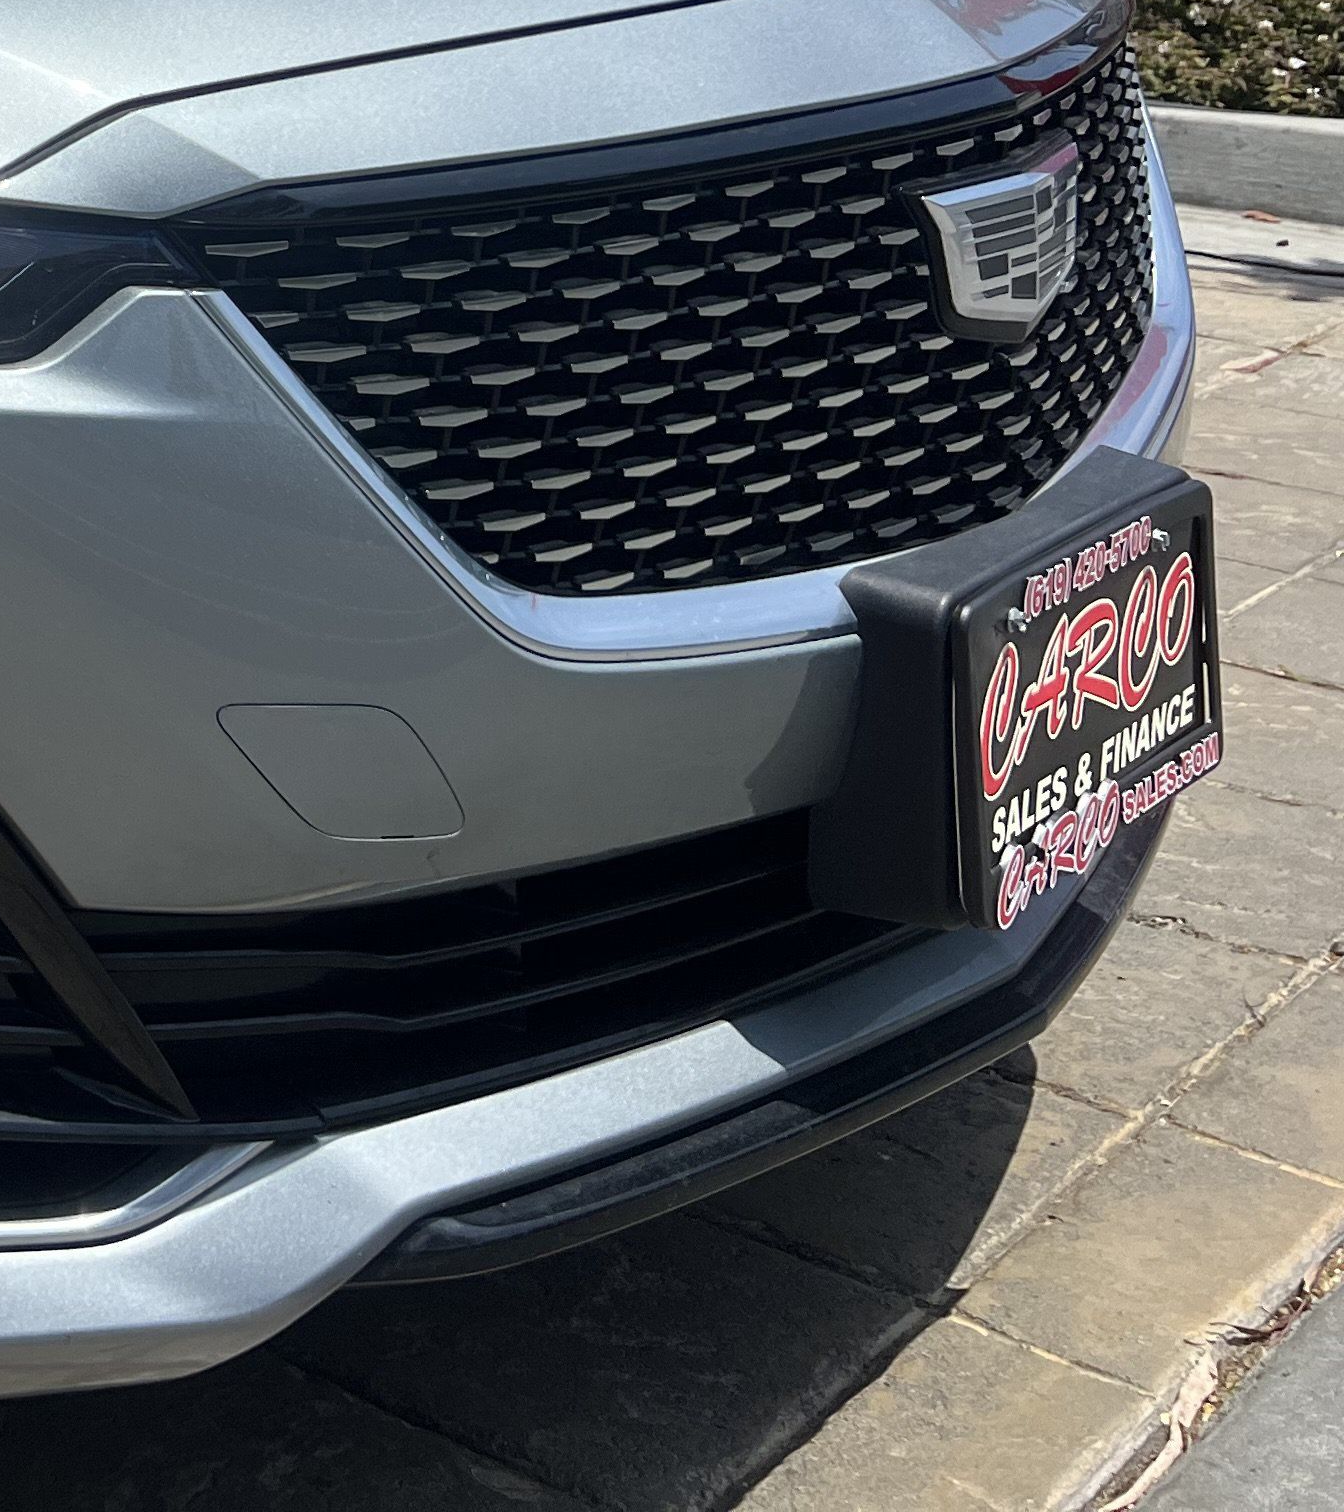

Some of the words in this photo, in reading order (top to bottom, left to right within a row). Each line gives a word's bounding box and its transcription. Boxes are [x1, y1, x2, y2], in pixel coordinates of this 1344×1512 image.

[1023, 557, 1073, 623] (619)
[1072, 515, 1152, 592] 420-5700
[979, 552, 1196, 803] CARCO
[991, 766, 1069, 853] SALES
[1073, 752, 1093, 797] &
[1099, 683, 1197, 783] FINANCE
[997, 779, 1120, 931] CARCO
[1122, 731, 1220, 825] SALES.COM
